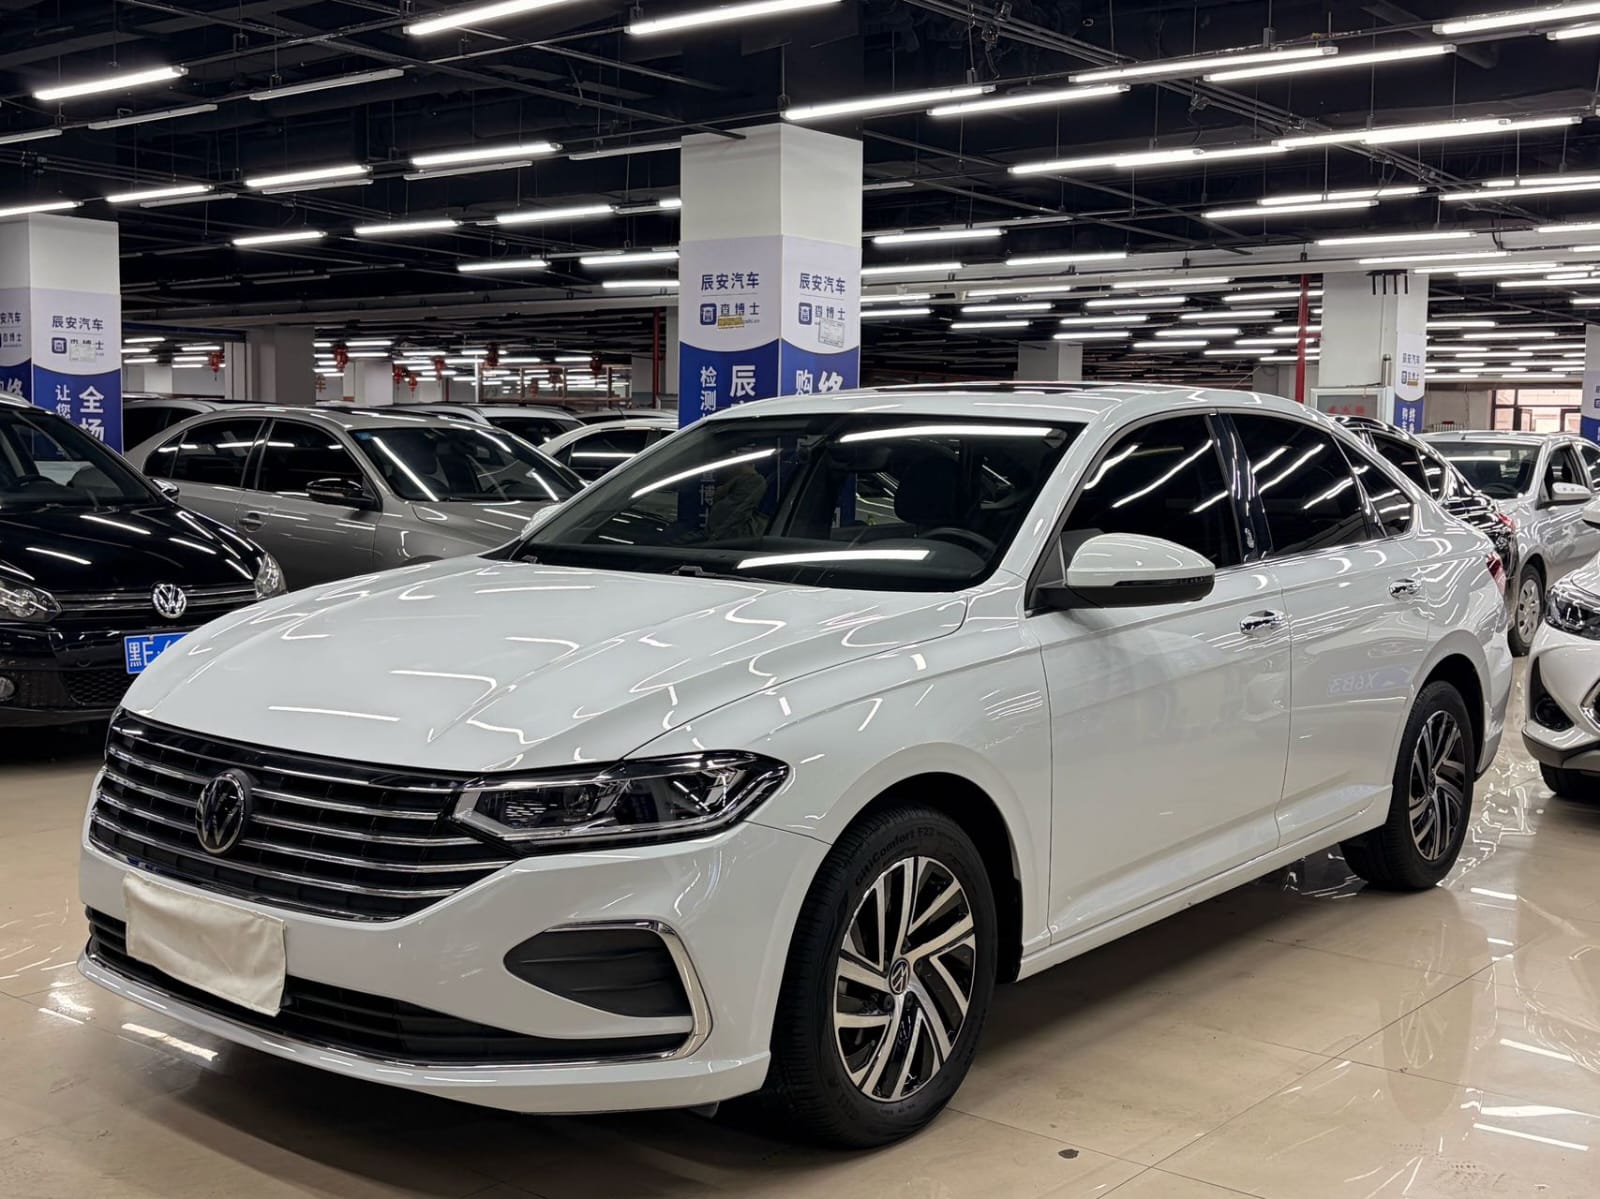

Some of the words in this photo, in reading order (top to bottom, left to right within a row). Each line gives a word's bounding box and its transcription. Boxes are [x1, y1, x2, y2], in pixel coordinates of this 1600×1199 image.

[700, 272, 760, 291] 辰安汽车
[799, 273, 846, 295] 辰安汽车
[52, 315, 104, 331] 辰安汽车
[55, 384, 71, 418] 让您
[700, 365, 718, 418] 检测
[730, 364, 756, 406] 辰
[79, 385, 105, 442] 全场
